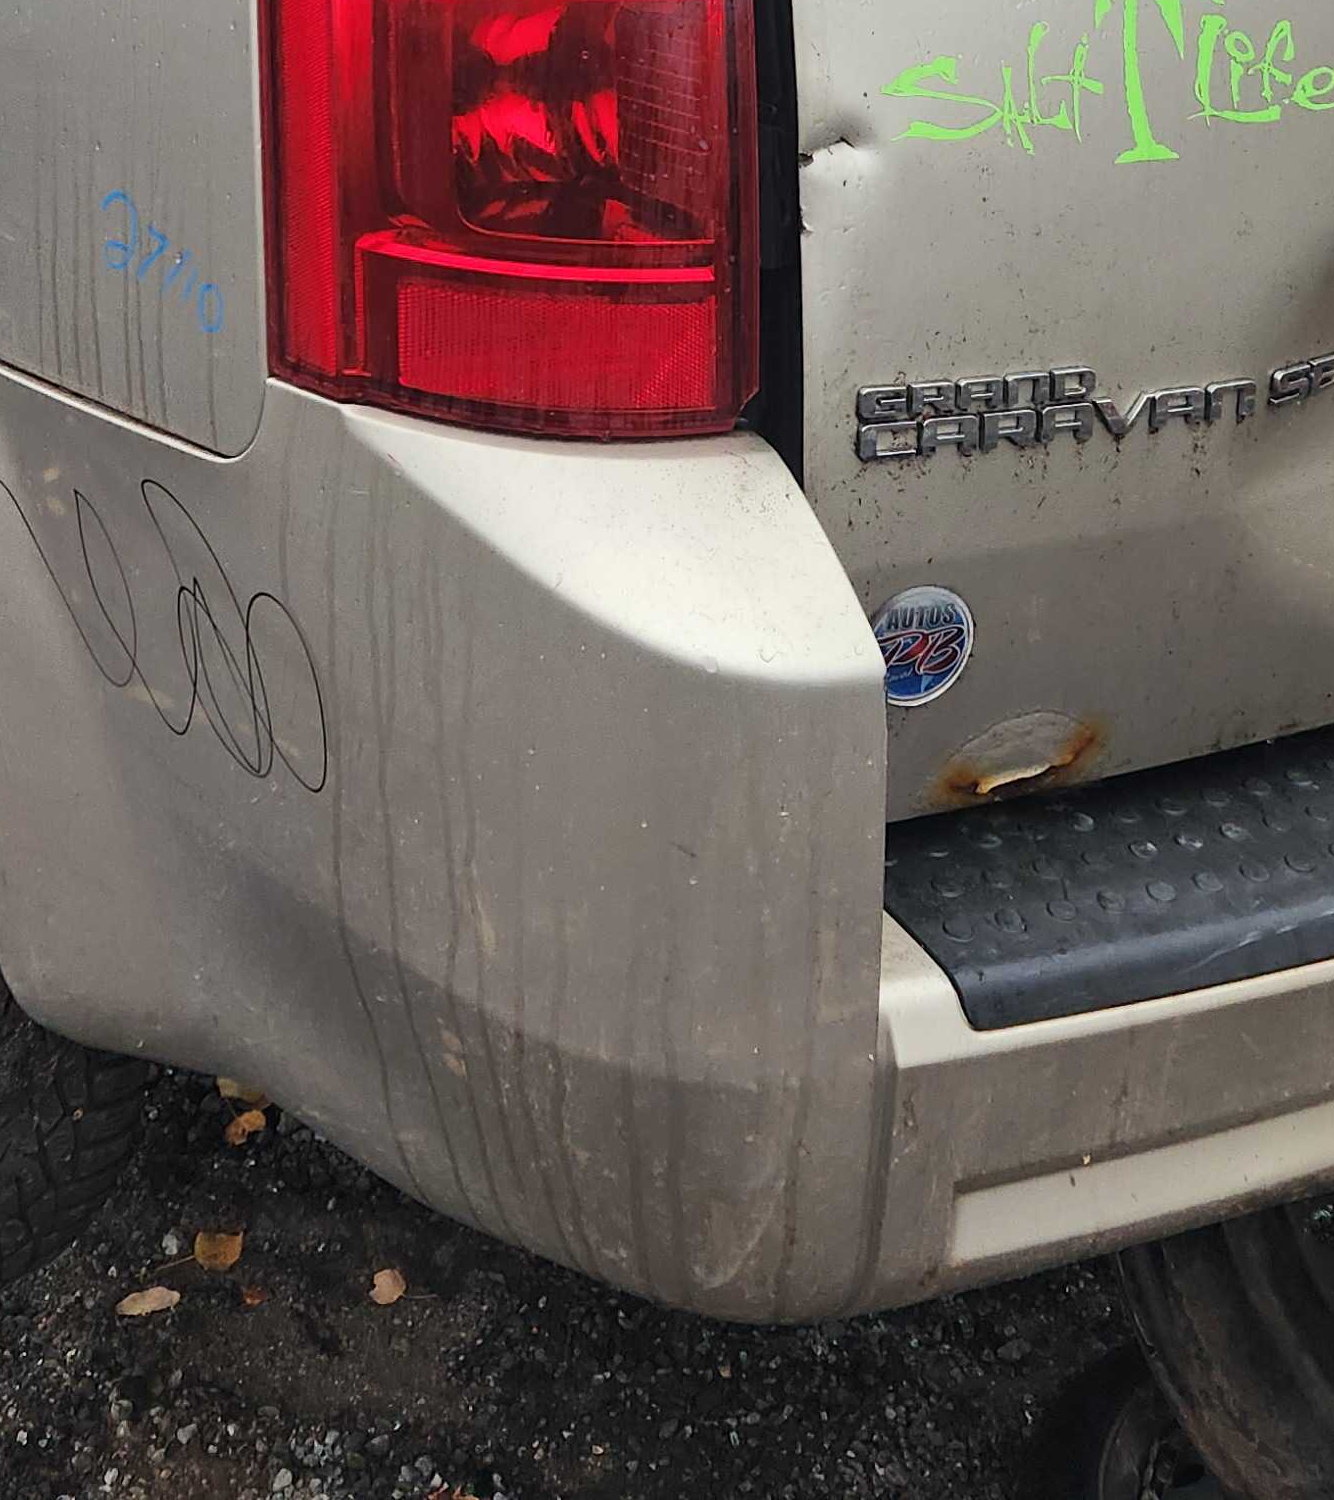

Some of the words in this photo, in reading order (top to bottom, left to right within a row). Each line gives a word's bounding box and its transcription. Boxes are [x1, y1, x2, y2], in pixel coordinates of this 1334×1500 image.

[856, 365, 1098, 420] GRAND
[854, 377, 1259, 462] CARAVAN
[886, 602, 958, 631] AUTOS
[877, 624, 967, 675] PB
